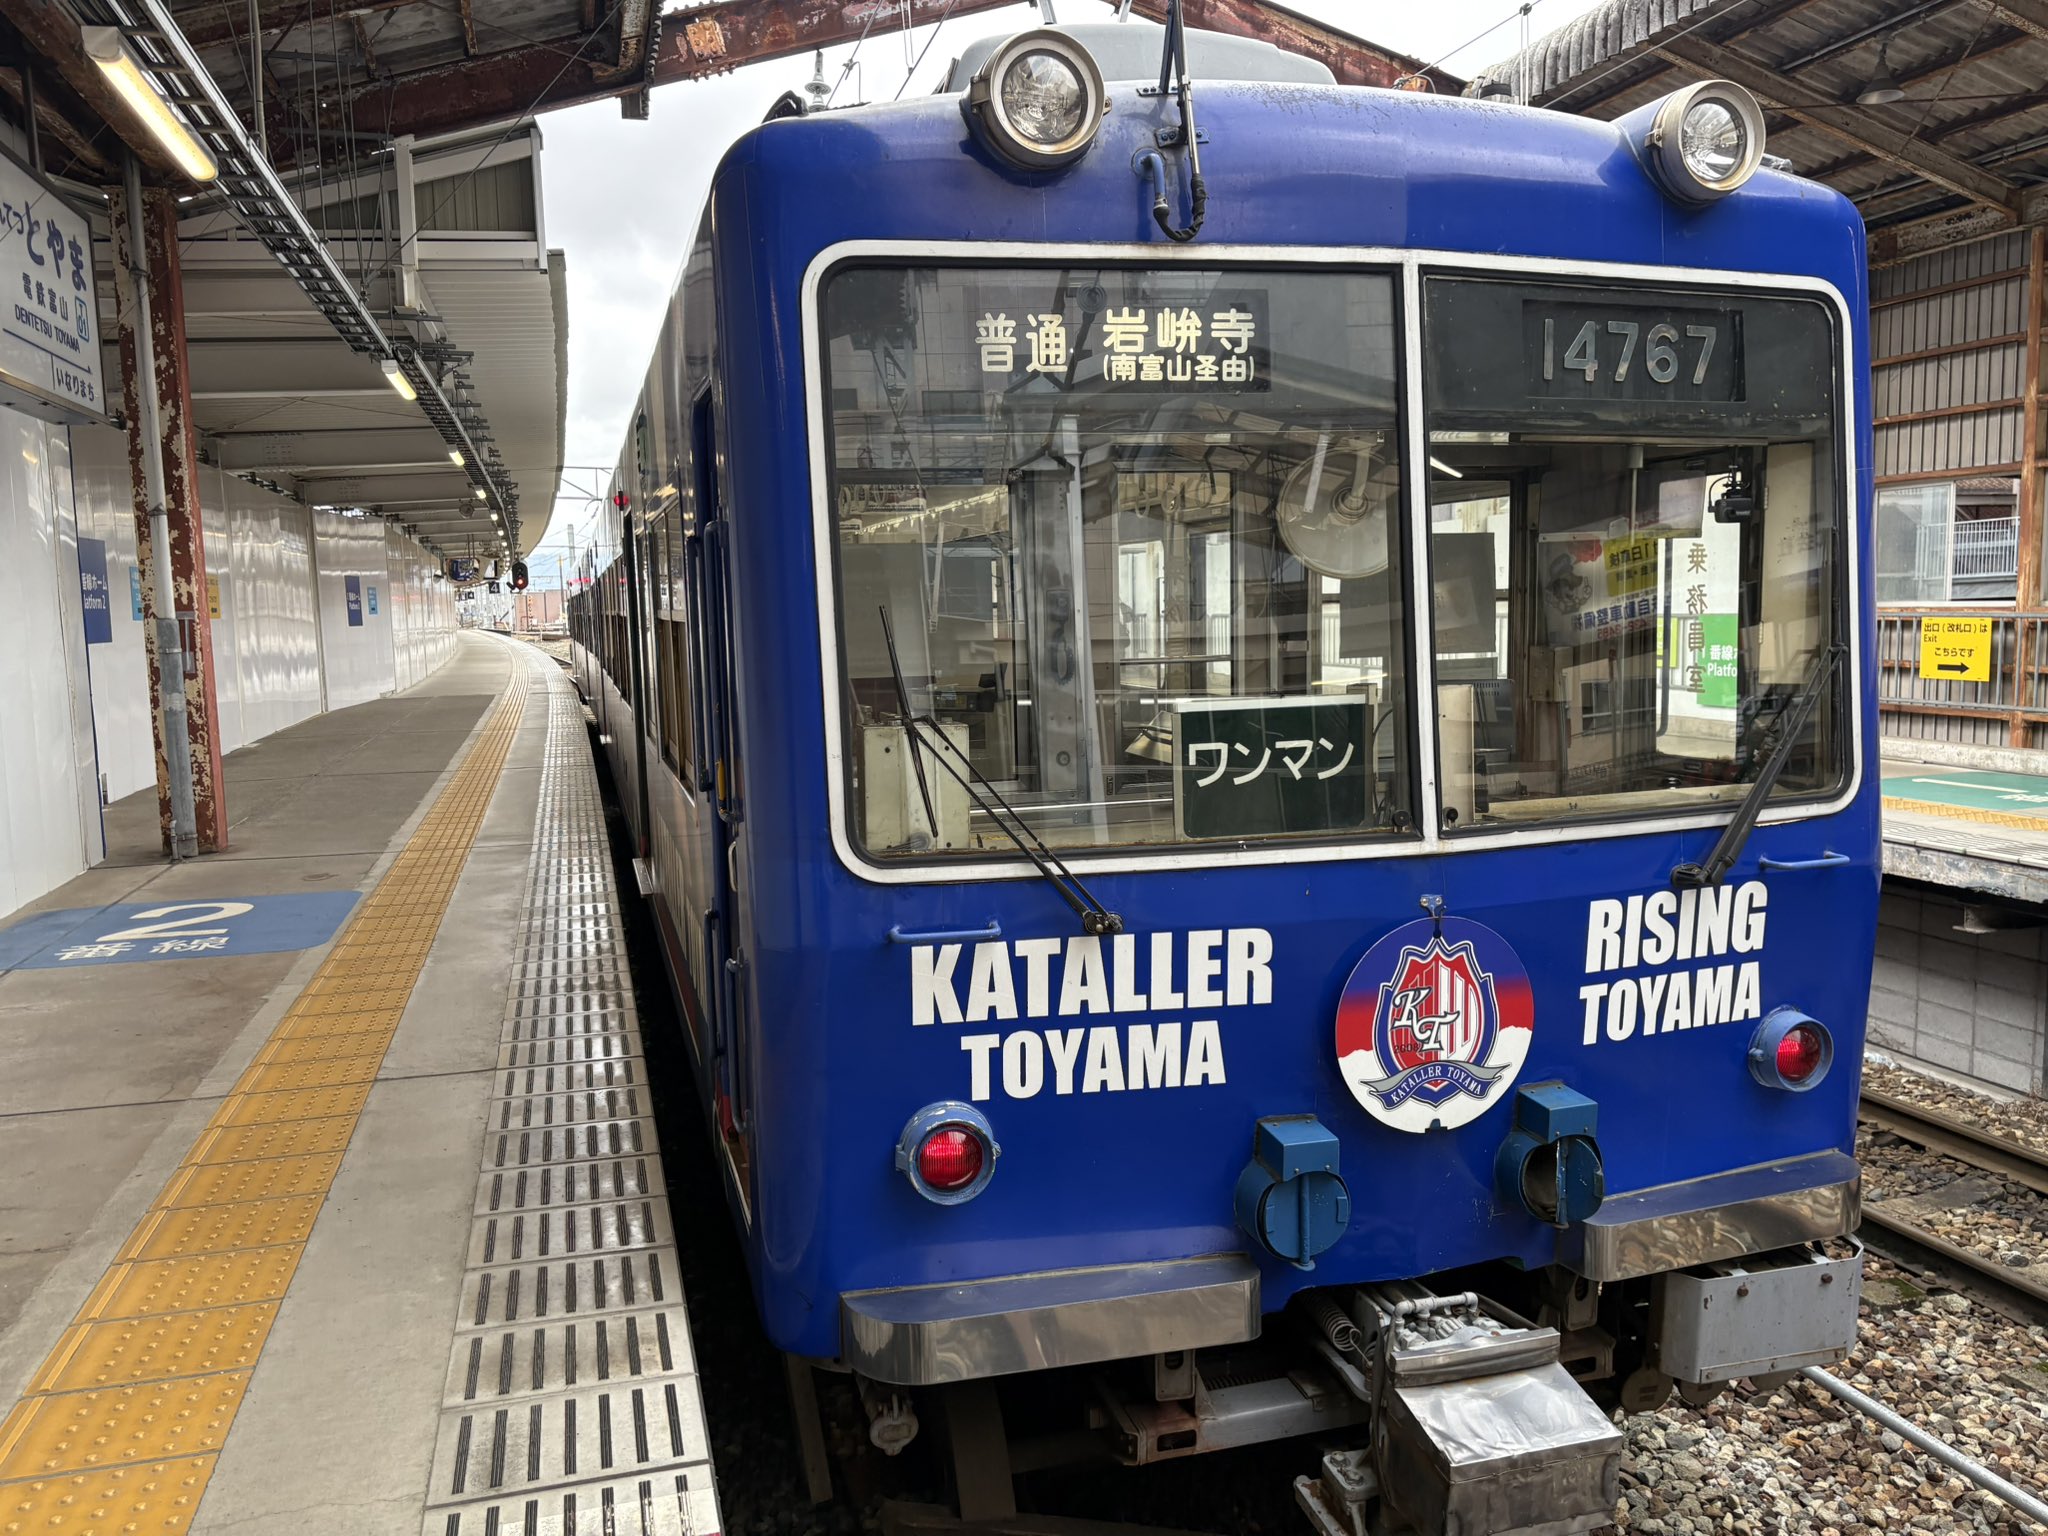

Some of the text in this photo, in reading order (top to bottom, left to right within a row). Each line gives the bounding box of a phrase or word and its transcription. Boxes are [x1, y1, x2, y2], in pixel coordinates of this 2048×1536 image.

[22, 271, 68, 322] 電鉄富山
[15, 304, 80, 353] DENTETSU TOYAMA
[975, 306, 1255, 373] 普通 岩峅寺
[1543, 317, 1717, 385] 14767
[56, 367, 94, 402] いなりまち
[1923, 634, 1937, 643] Exit
[1935, 647, 1974, 658] こちらです
[1188, 739, 1355, 788] ワンマン
[96, 902, 254, 942] 2
[1586, 881, 1767, 974] RISING
[54, 936, 230, 961] 番線
[911, 928, 1272, 1027] KATALLER
[1579, 961, 1761, 1046] TOYAMA
[961, 1019, 1226, 1101] TOYAMA
[1391, 1065, 1482, 1104] KATALLER TOYAMA
